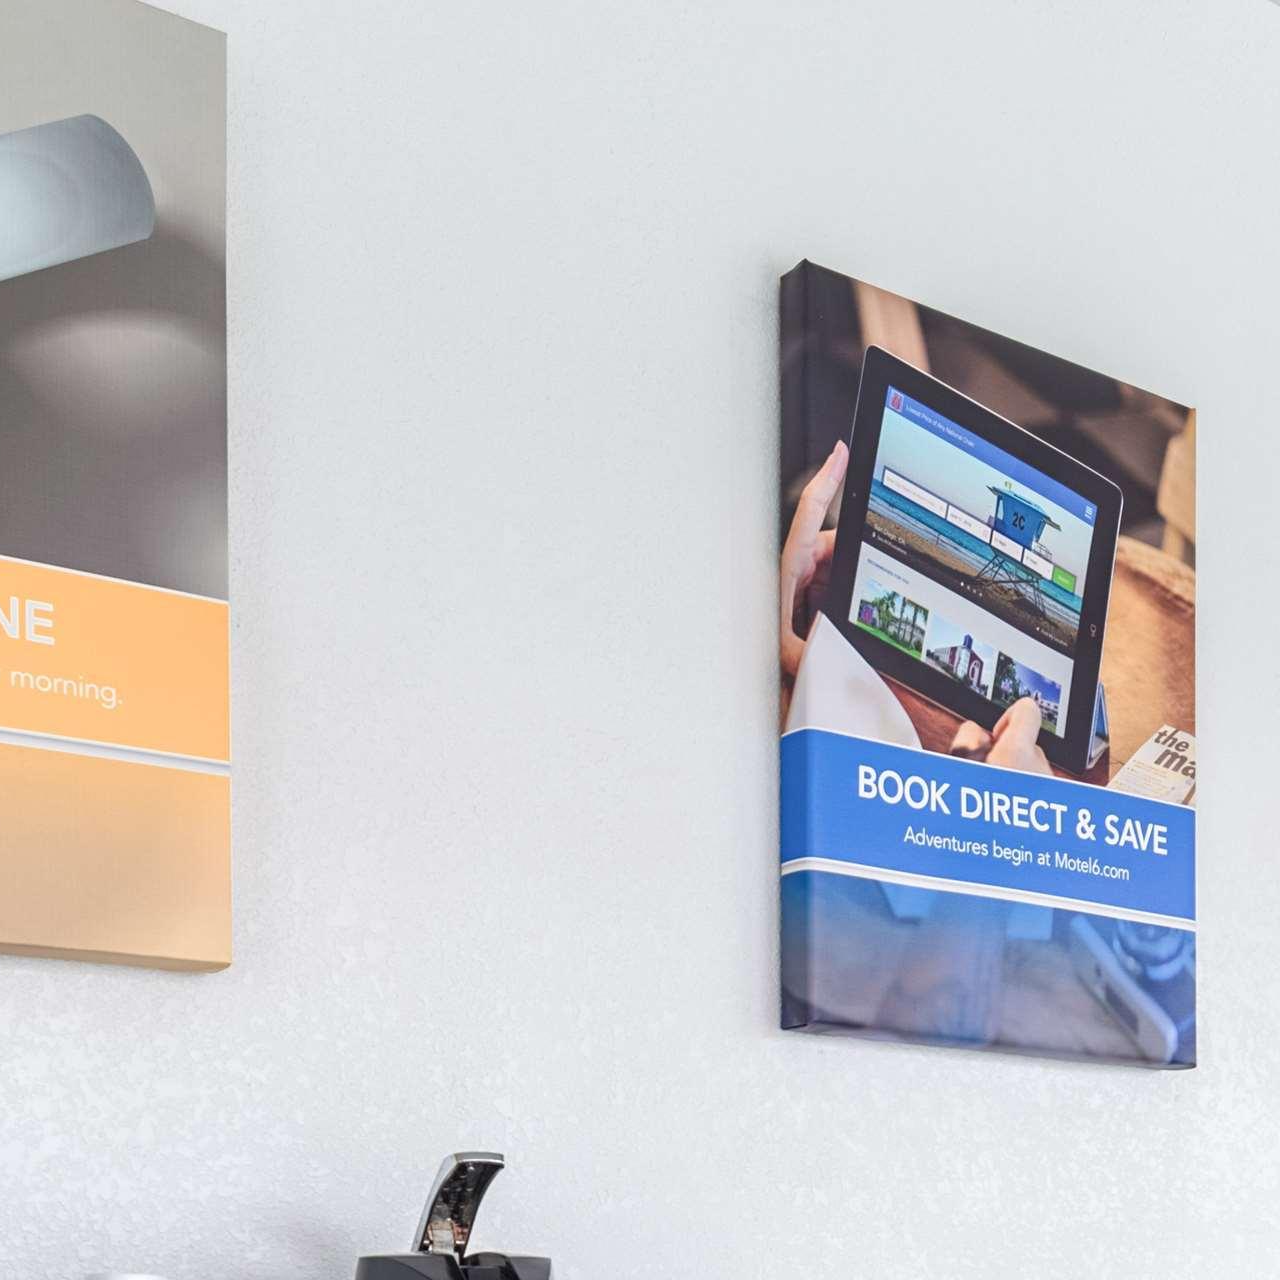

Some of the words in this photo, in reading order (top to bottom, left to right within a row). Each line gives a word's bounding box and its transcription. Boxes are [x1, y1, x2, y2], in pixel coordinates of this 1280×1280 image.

[10, 670, 124, 709] morning.
[1154, 728, 1190, 752] the
[857, 764, 951, 816] BOOK
[960, 786, 1068, 835] DIRECT
[1076, 807, 1097, 842] &
[1105, 814, 1169, 856] SAVE
[904, 825, 988, 857] Adventures
[992, 840, 1033, 866] begin
[1037, 849, 1051, 866] at
[1054, 853, 1130, 881] Motel6.com
